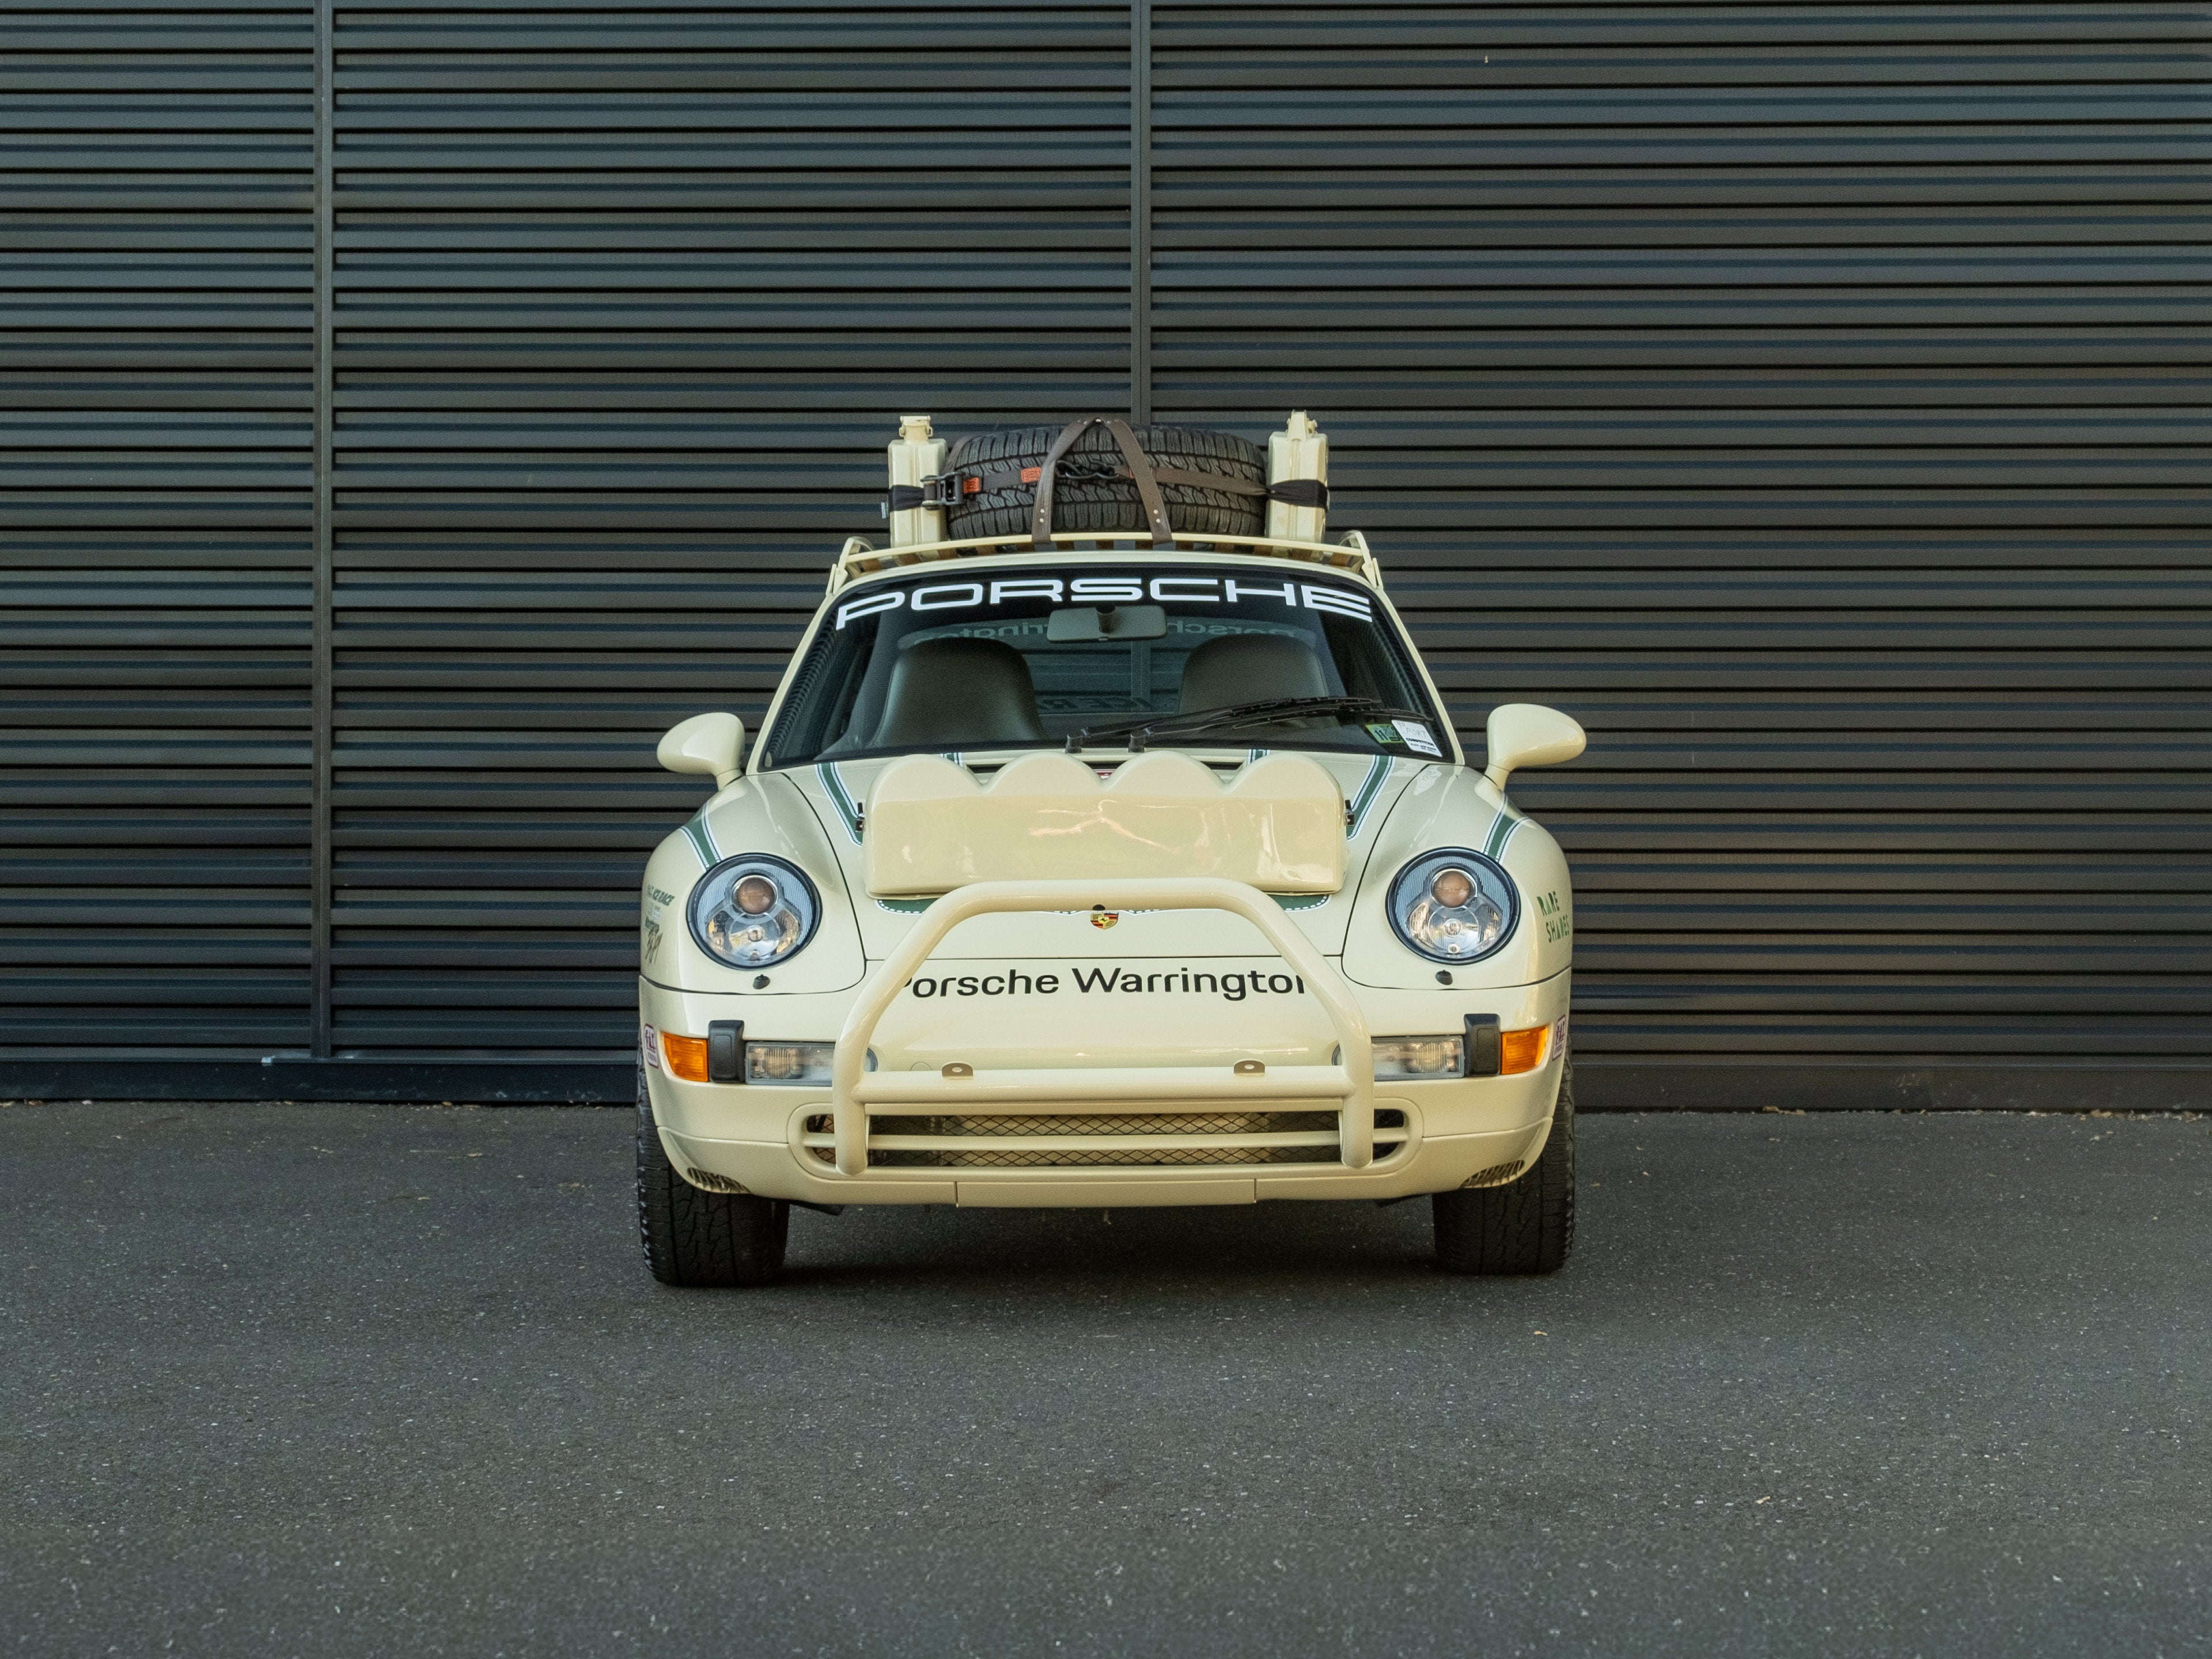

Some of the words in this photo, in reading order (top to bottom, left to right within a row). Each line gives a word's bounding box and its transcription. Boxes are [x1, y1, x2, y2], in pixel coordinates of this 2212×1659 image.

[836, 579, 1372, 630] PORSCHE
[1536, 891, 1560, 916] RARE
[1546, 914, 1570, 943] SHADES
[904, 969, 1059, 998] orsche
